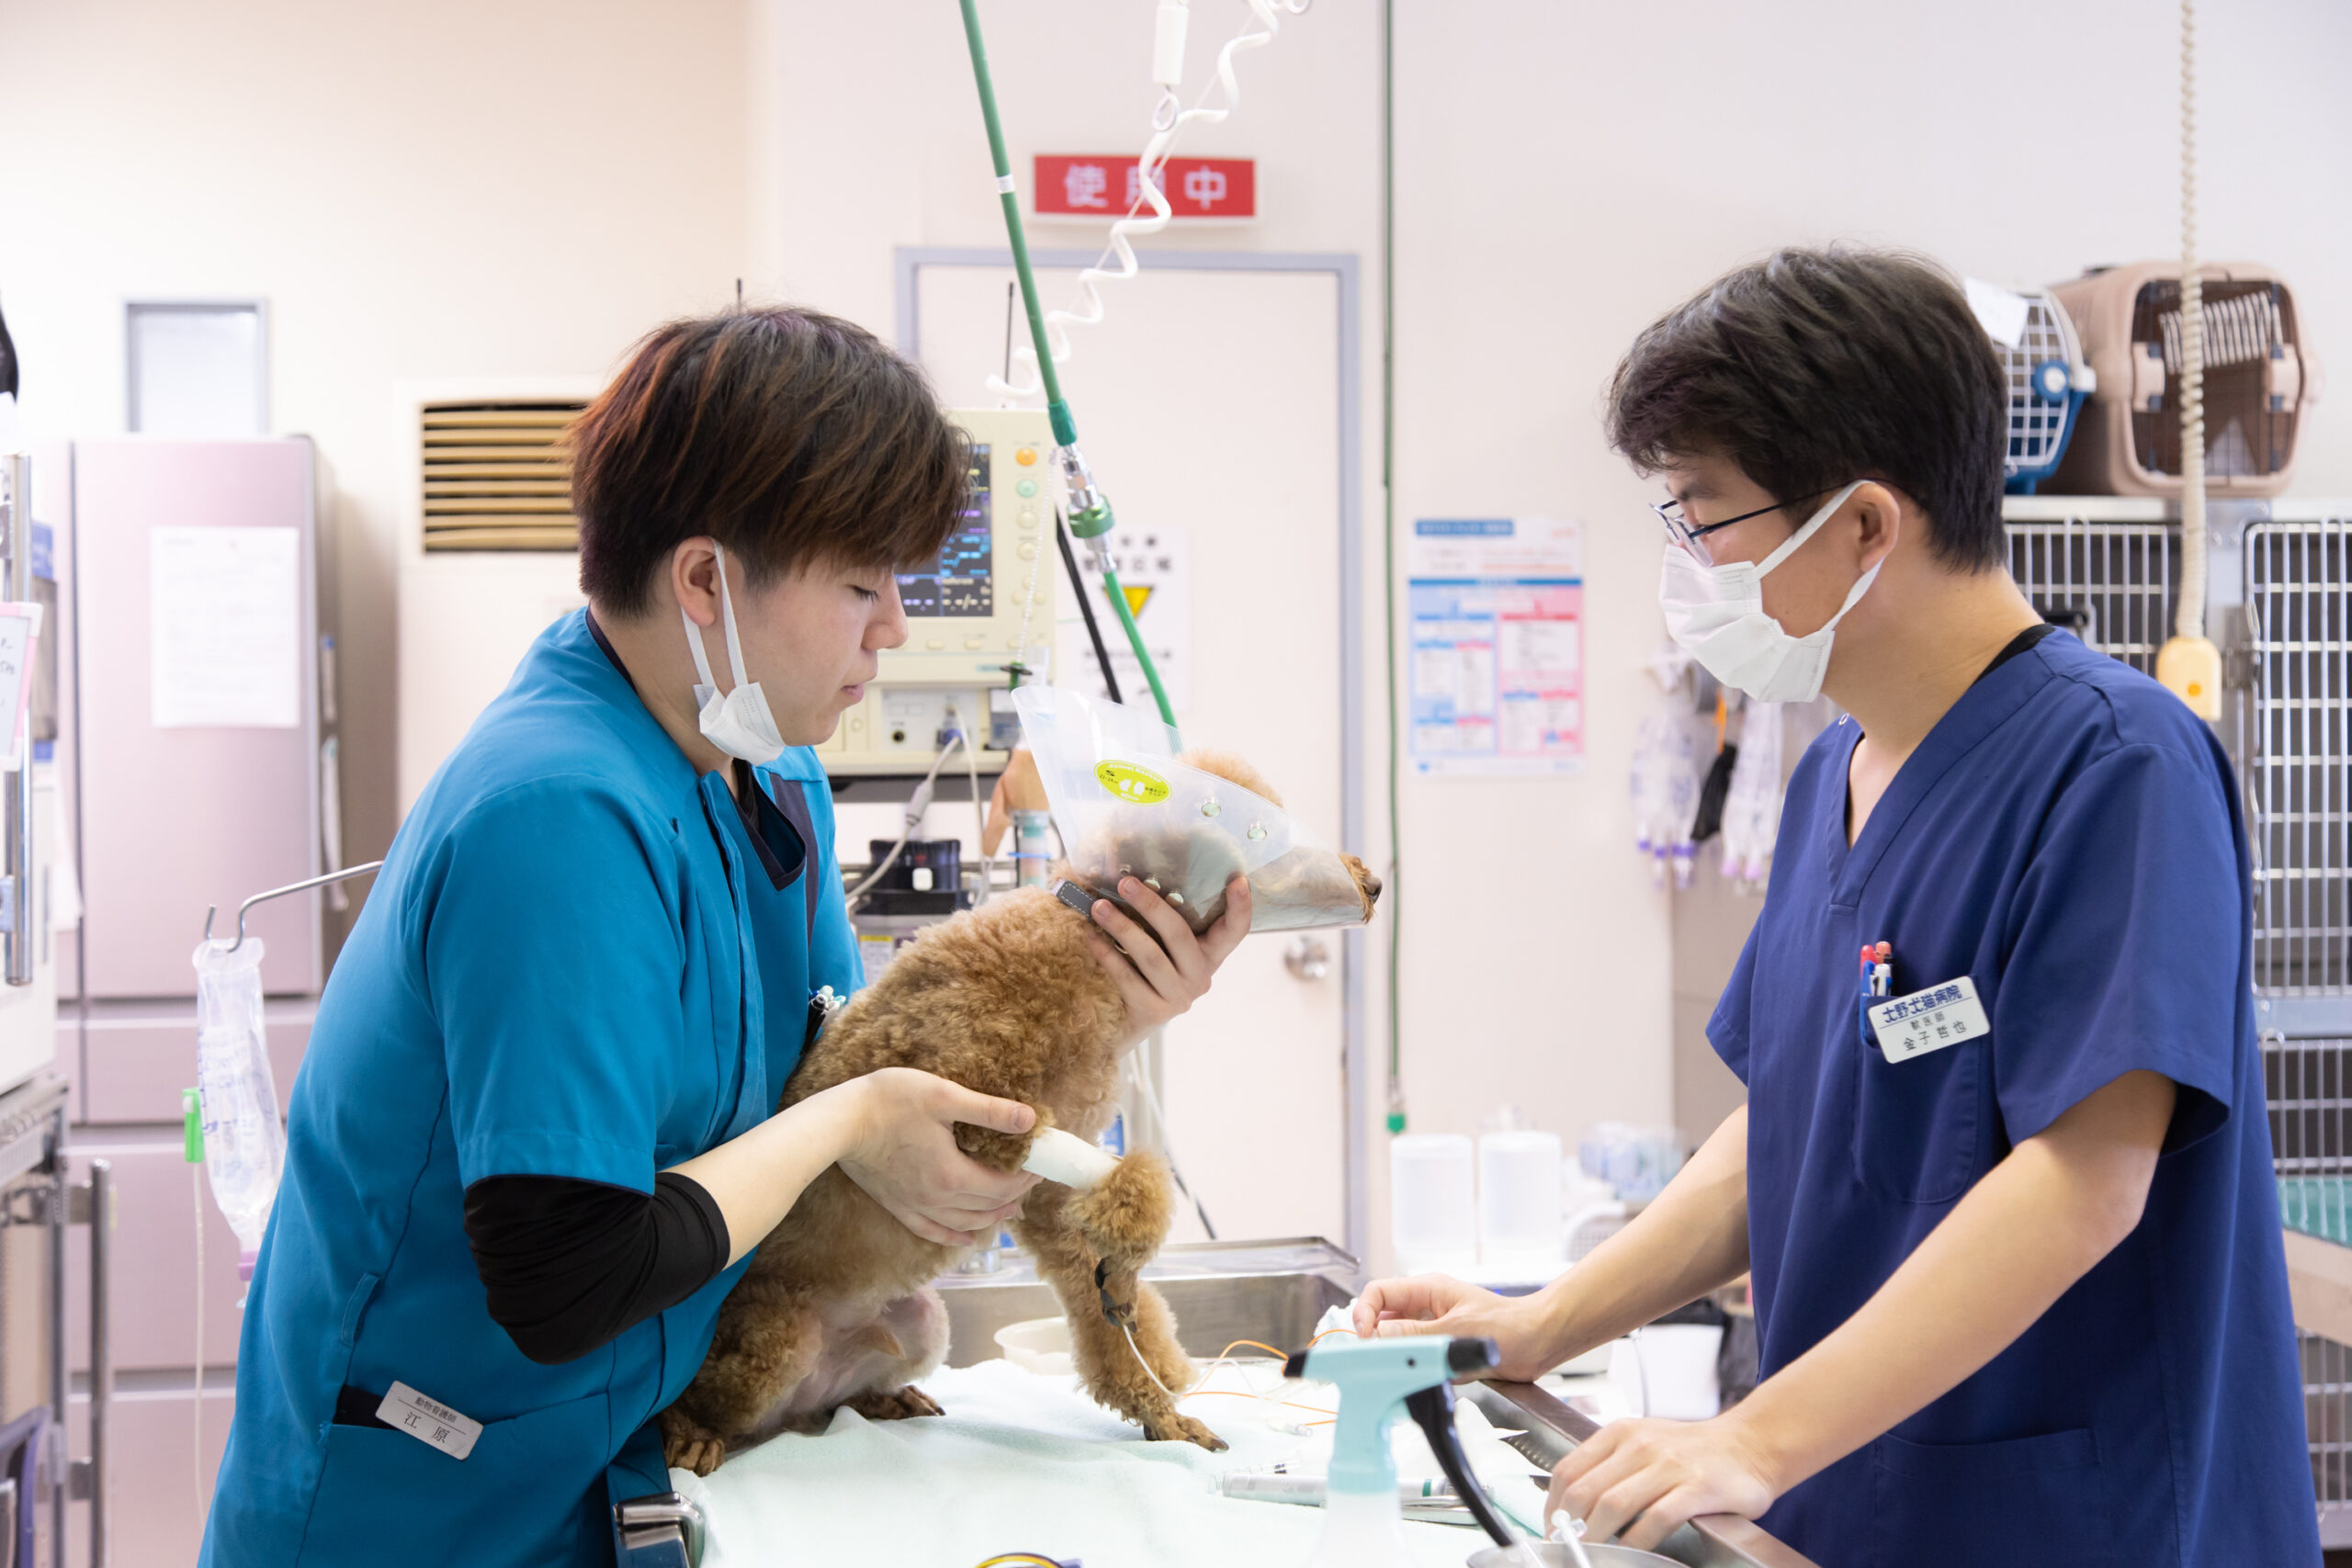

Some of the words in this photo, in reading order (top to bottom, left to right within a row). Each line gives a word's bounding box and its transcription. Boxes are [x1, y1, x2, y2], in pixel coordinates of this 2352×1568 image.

[1064, 165, 1227, 209] 使用中
[414, 1396, 458, 1423] 動物看護師
